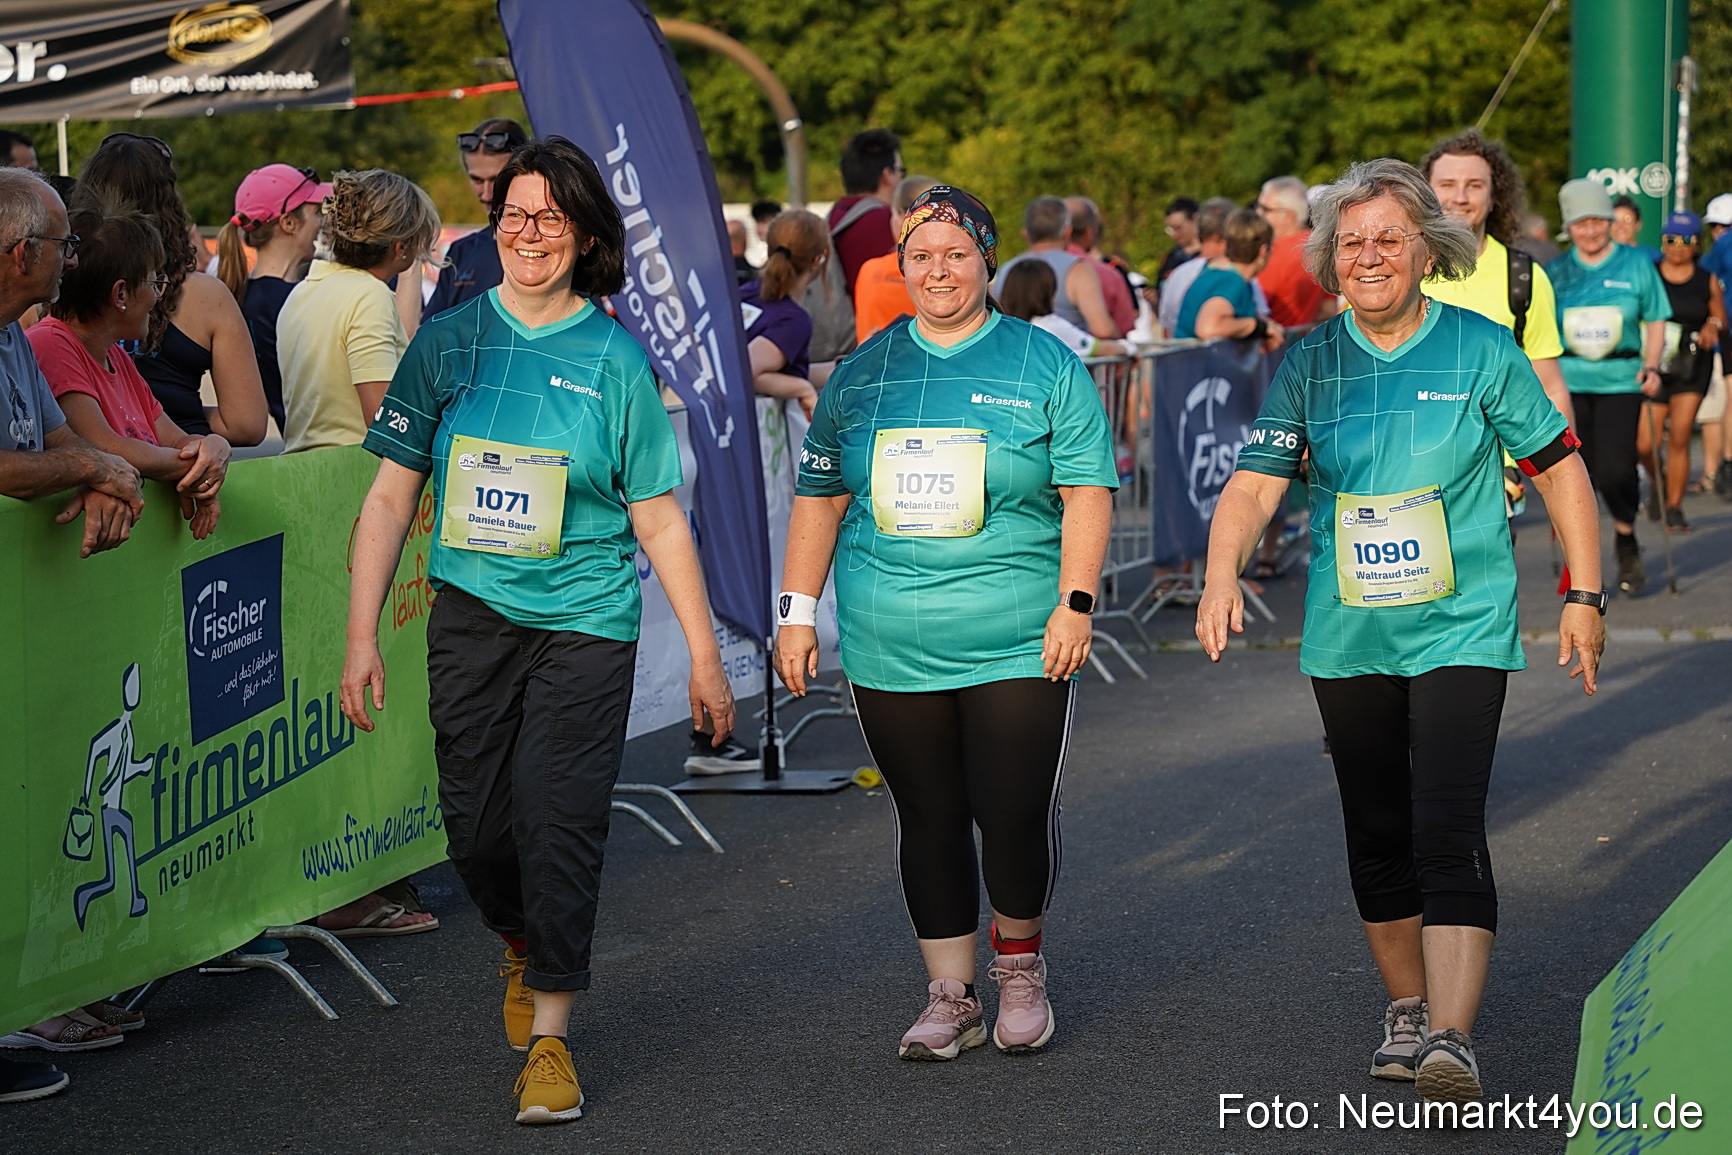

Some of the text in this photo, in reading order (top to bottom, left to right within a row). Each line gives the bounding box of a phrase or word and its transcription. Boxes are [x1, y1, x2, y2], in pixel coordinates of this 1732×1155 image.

[130, 76, 158, 95] Ein
[195, 73, 227, 92] der
[562, 379, 603, 402] Grasruck
[983, 394, 1032, 409] Grasruck
[900, 448, 934, 456] Firmenlauf
[476, 462, 513, 472] Firmenlauf
[896, 473, 955, 495] 1075
[475, 486, 529, 515] 1071
[895, 500, 960, 510] Melanie Ellert
[468, 513, 505, 527] Daniela
[507, 518, 537, 532] Bauer
[1355, 517, 1388, 525] Firmenlauf
[1353, 539, 1421, 565] 1090
[1355, 566, 1430, 580] Waltraud Seitz
[203, 597, 267, 646] Fischer
[210, 627, 263, 662] AUTOMOBILE
[151, 677, 355, 850] firmenlau
[302, 785, 444, 881] www.firmenlauf-o
[158, 809, 255, 895] neumarkt
